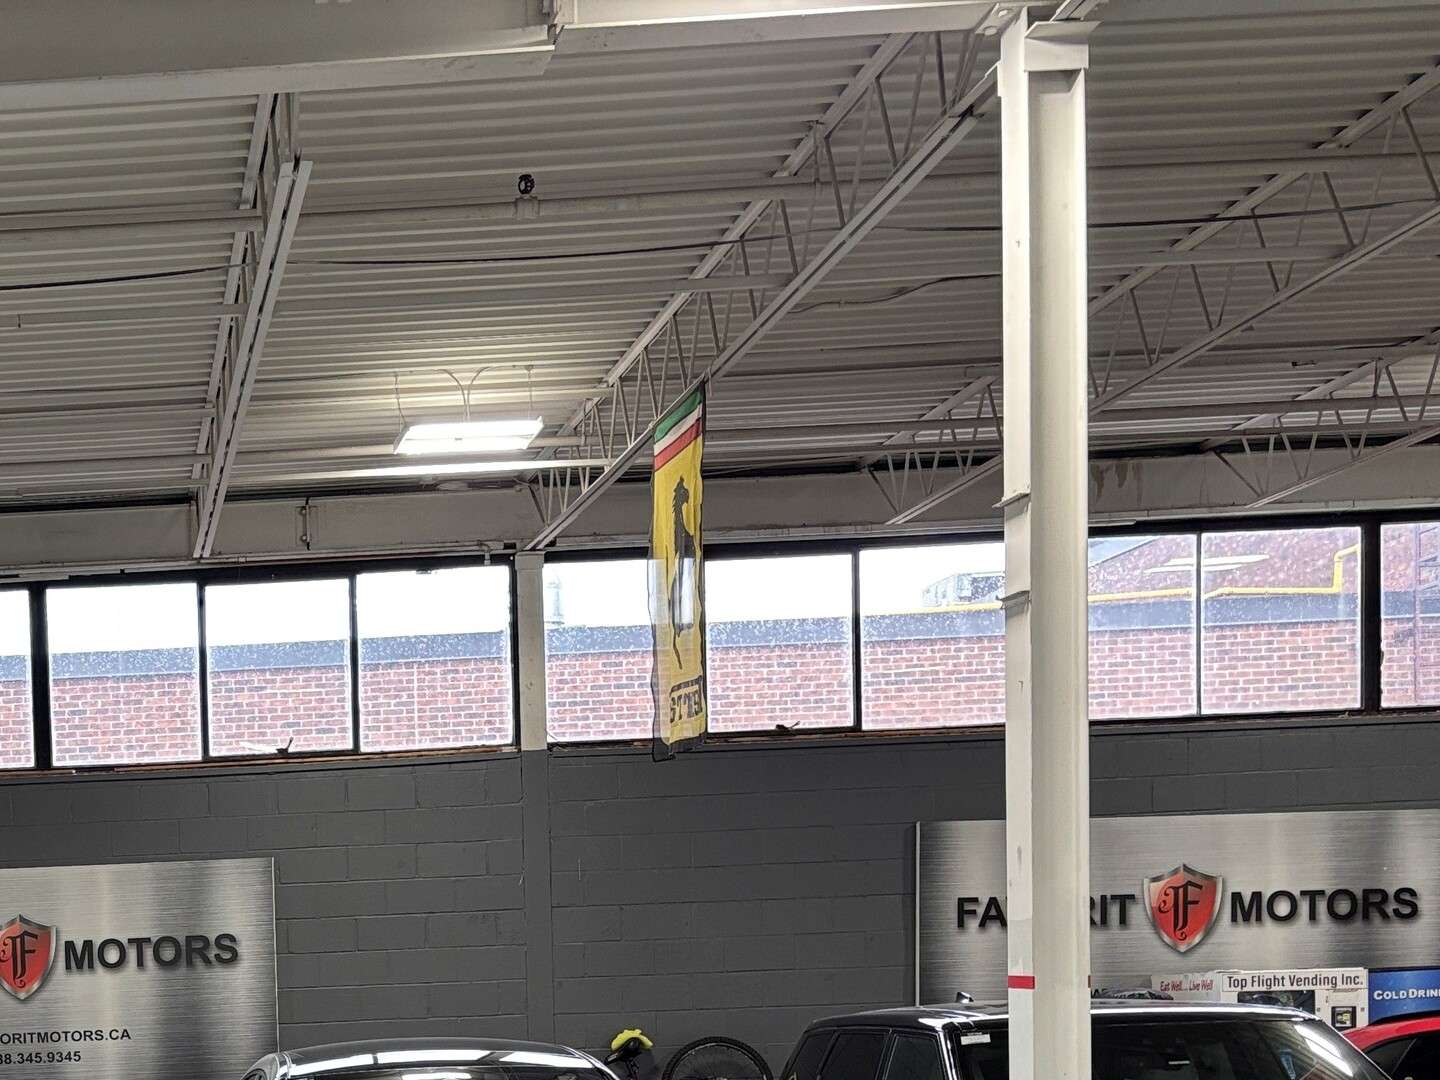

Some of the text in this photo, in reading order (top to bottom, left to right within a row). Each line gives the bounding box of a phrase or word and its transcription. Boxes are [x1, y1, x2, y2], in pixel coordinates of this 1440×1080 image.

[957, 894, 1136, 929] FAIT
[1230, 888, 1419, 923] MOTORS
[64, 933, 239, 971] MOTORS
[1227, 973, 1363, 990] Top Flight Vending Inc.
[1408, 988, 1440, 998] DRIN
